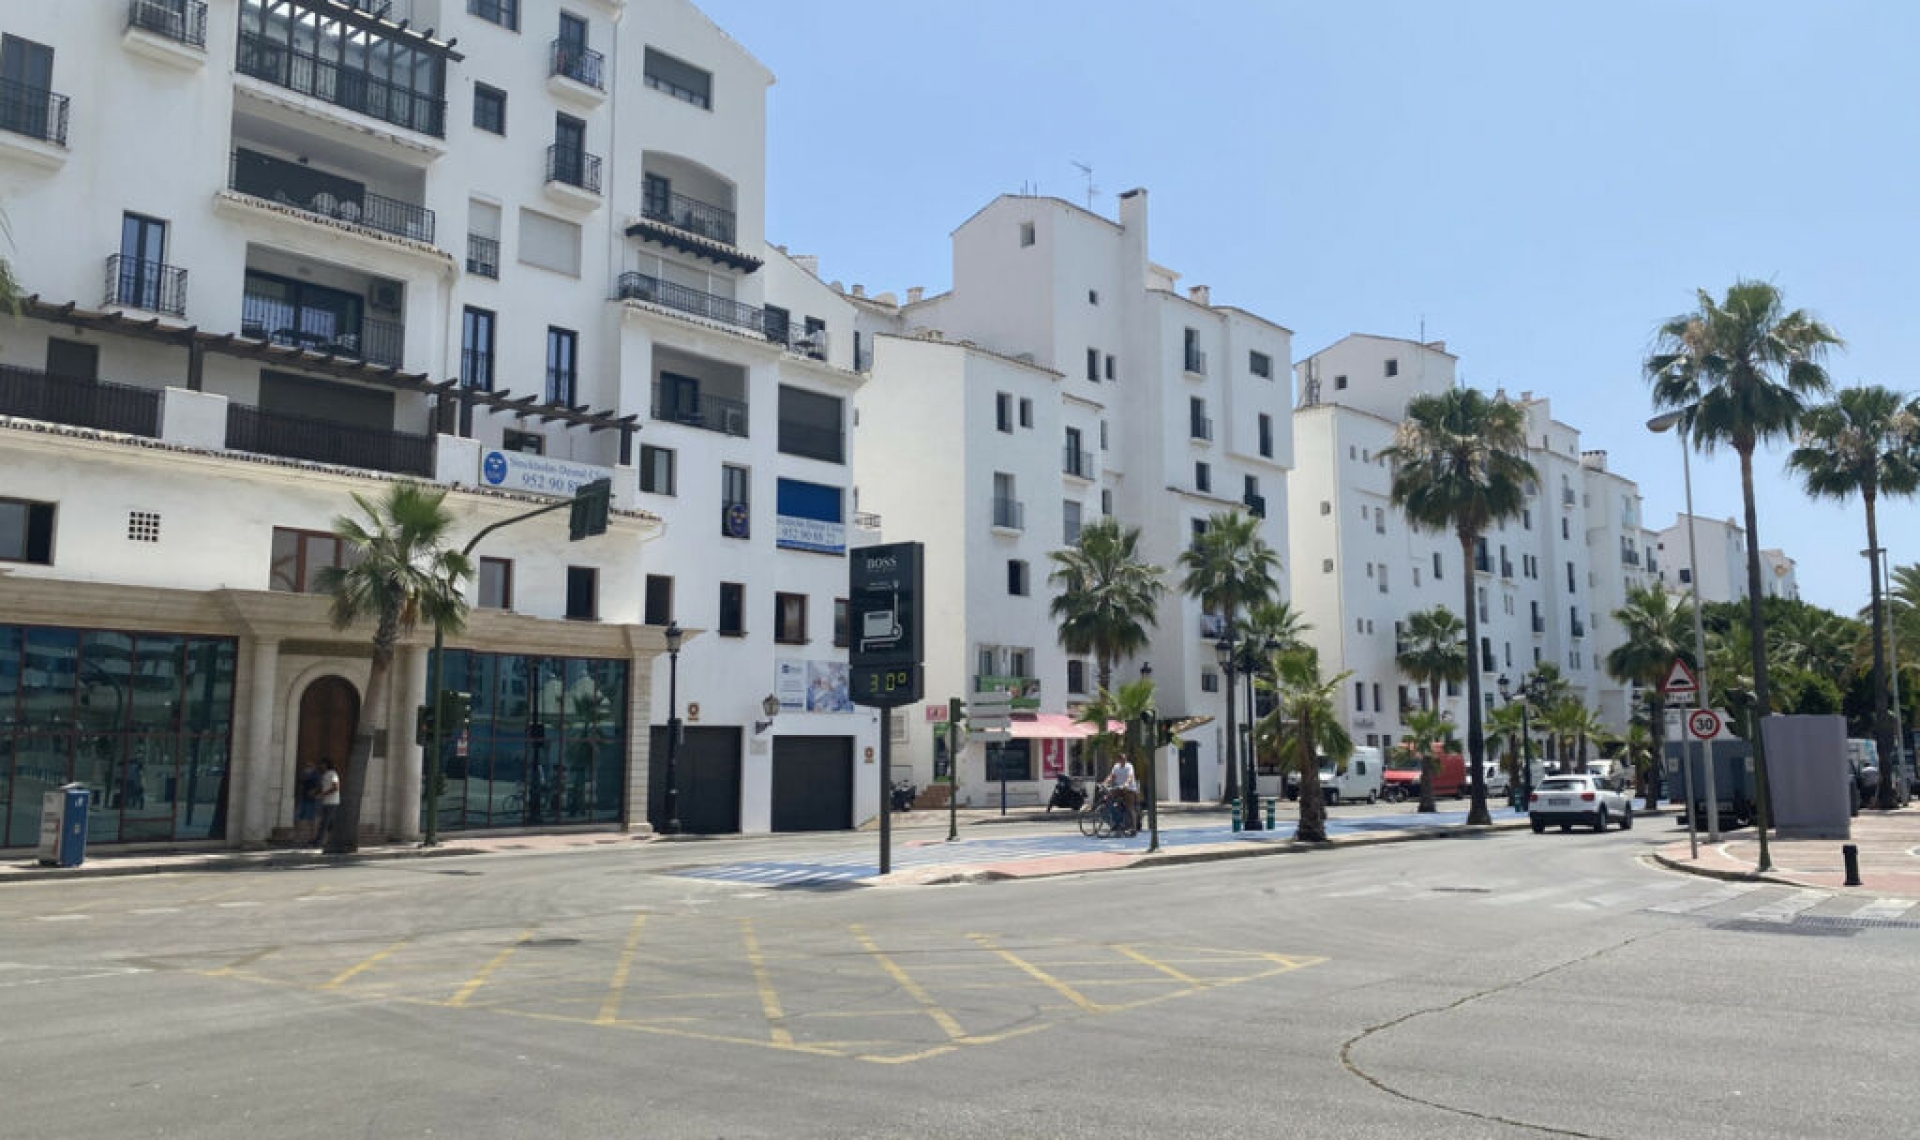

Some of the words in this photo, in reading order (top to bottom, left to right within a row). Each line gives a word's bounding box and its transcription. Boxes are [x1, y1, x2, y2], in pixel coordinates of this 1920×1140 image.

[523, 475, 545, 489] 952
[549, 478, 565, 491] 90
[866, 556, 898, 569] BOSS
[1696, 718, 1714, 730] 30
